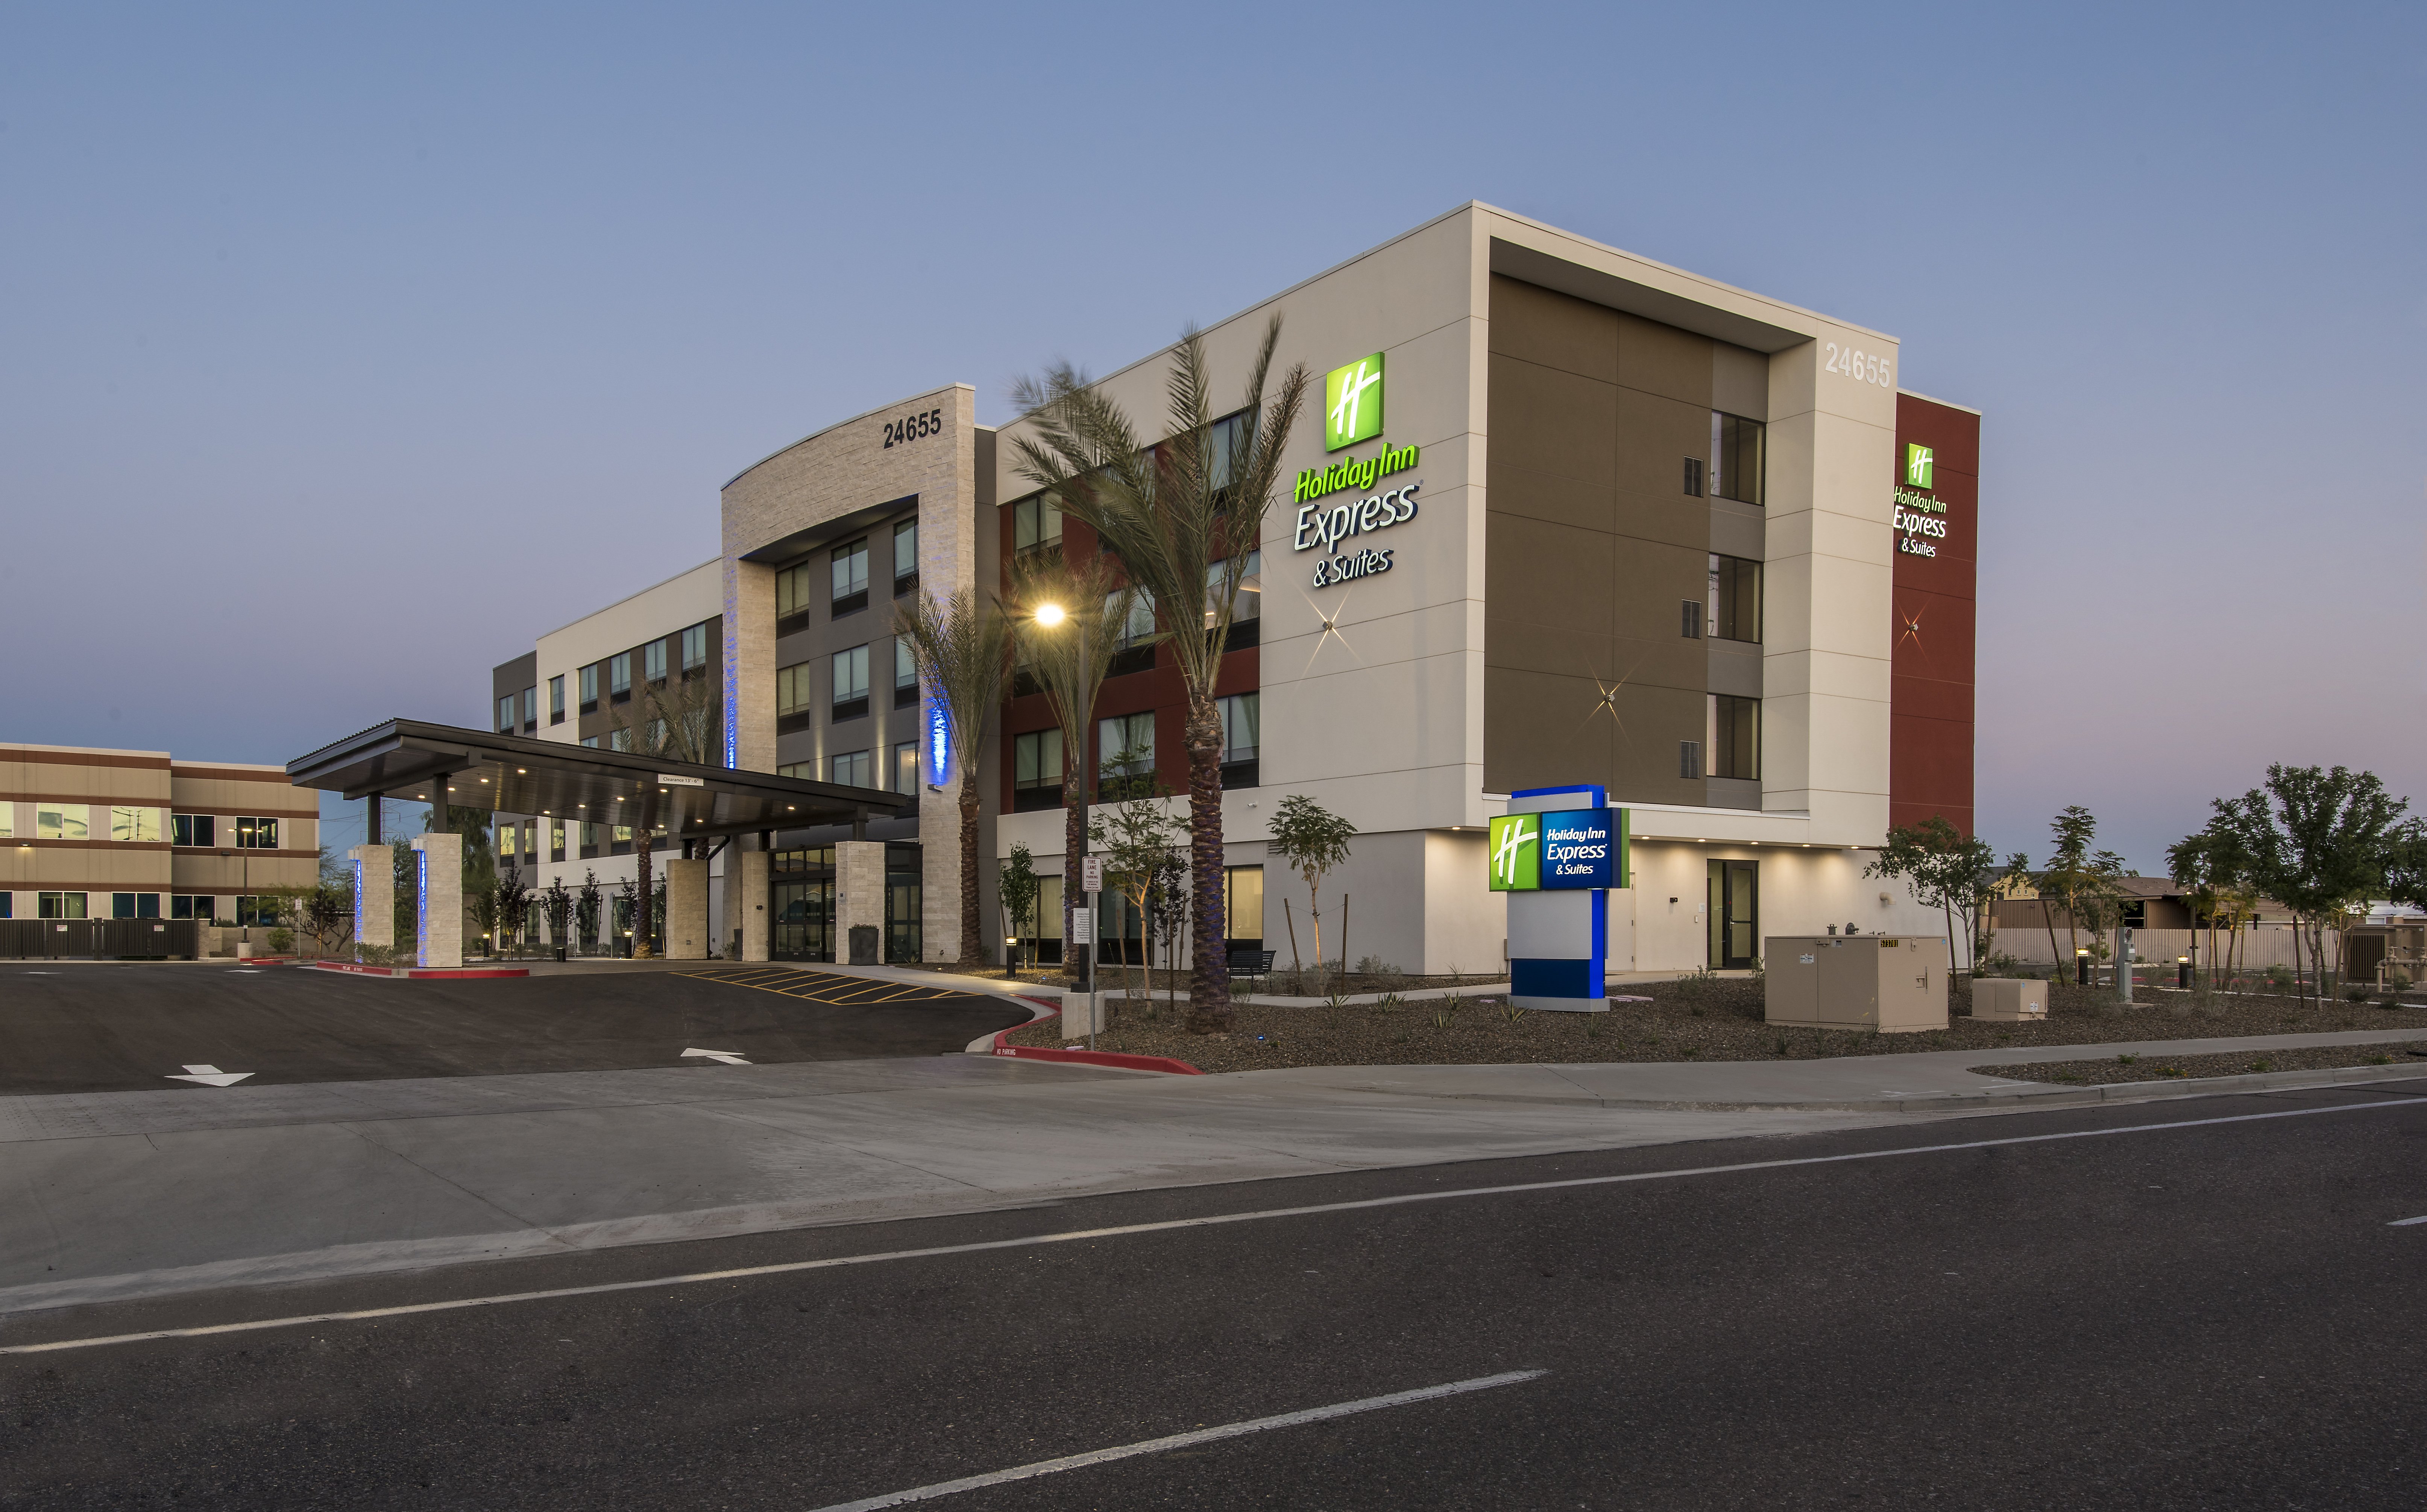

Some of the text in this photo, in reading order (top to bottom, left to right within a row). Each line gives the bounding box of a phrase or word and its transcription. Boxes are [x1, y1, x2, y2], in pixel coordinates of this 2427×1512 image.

[1825, 342, 1890, 388] 24655
[884, 408, 941, 449] 24655
[1294, 442, 1420, 503] Holiday Inn
[1894, 486, 1946, 513] Holiday Inn
[1294, 484, 1419, 554] Express
[1893, 505, 1946, 538] Express
[1902, 538, 1936, 557] & Suites
[1313, 549, 1394, 588] & Suites
[1547, 827, 1606, 842] Holiday Inn
[1547, 844, 1605, 864] Express
[1556, 864, 1594, 875] & Suites
